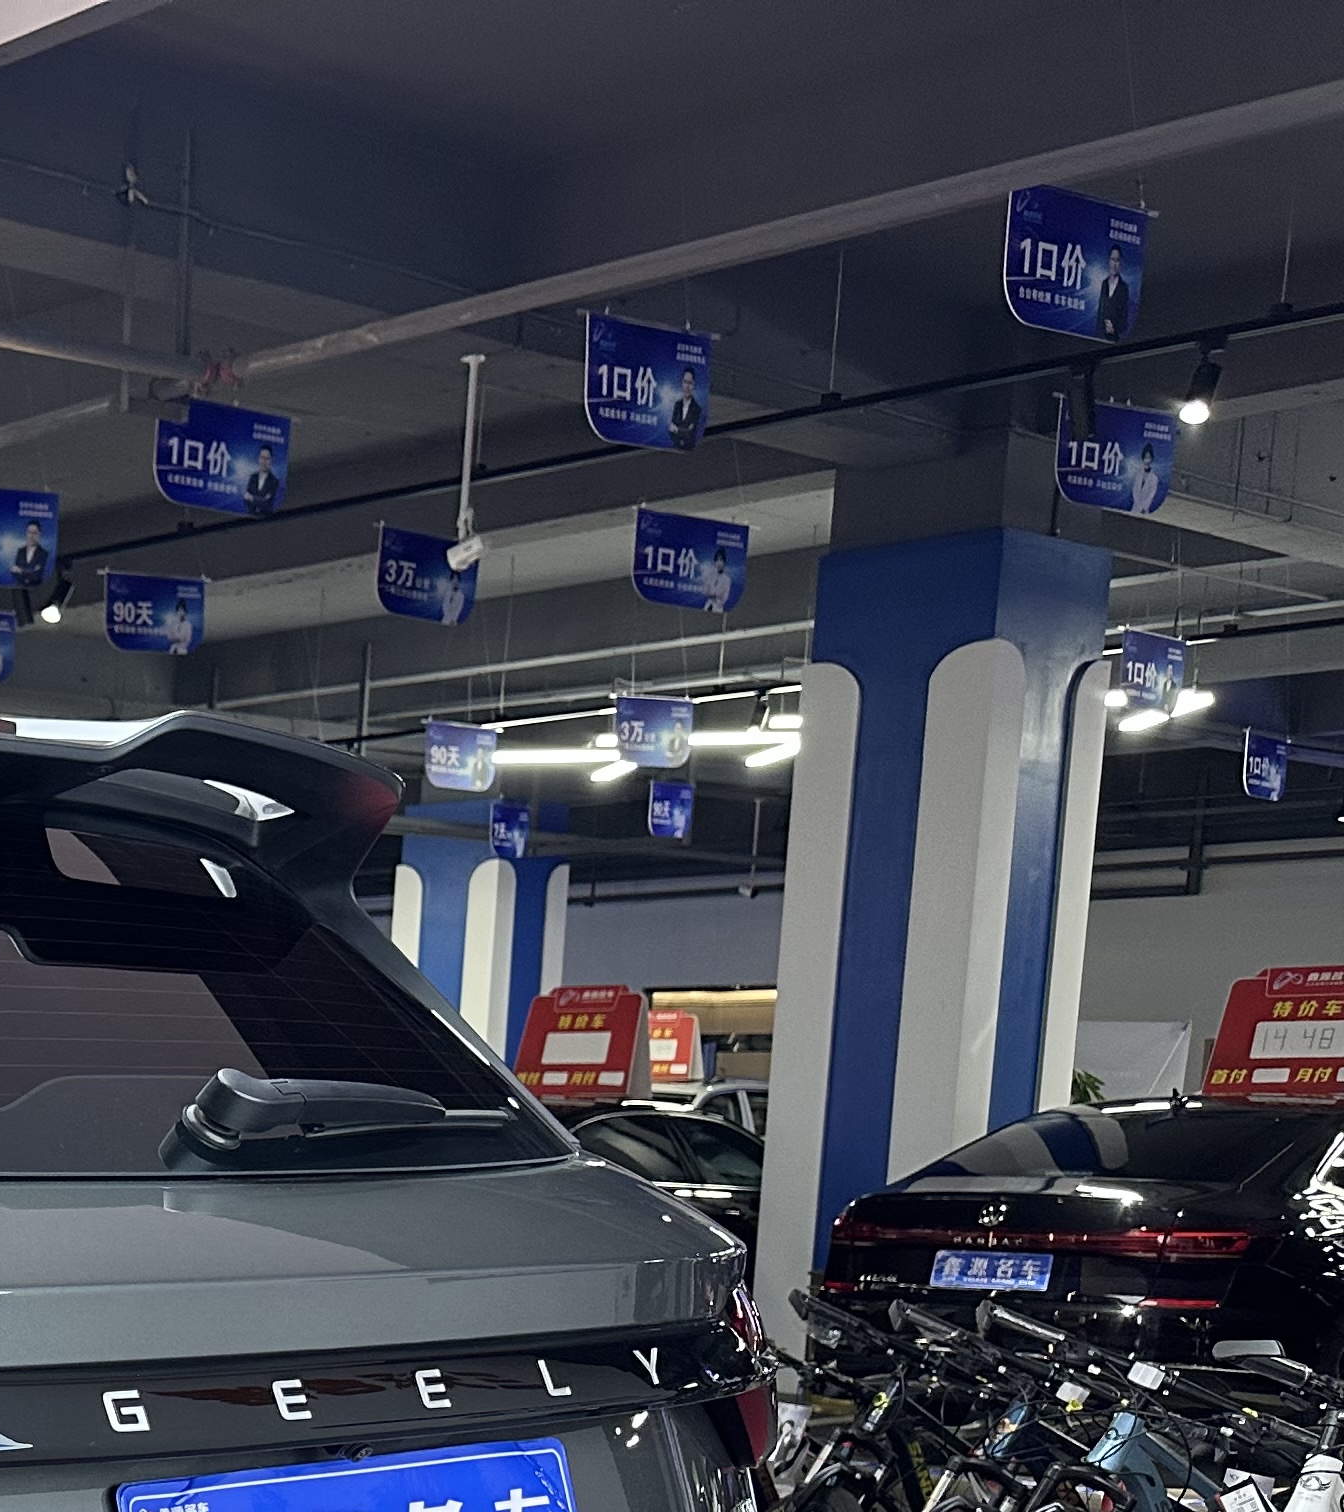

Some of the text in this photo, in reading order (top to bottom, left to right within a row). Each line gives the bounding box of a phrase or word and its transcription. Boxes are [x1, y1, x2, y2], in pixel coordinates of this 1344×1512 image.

[1020, 238, 1087, 290] 1口价
[598, 364, 657, 408] 1口价
[168, 436, 232, 478] 1口价
[1068, 441, 1124, 477] 1口价
[643, 545, 698, 579] 1口价
[113, 601, 154, 626] 90天
[1126, 660, 1158, 688] 1口价
[429, 745, 461, 767] 90天
[558, 1013, 607, 1030] 特价车
[1273, 1000, 1343, 1018] 特价车
[1211, 1067, 1333, 1084] 首付 月付
[102, 1346, 663, 1433] GEELY
